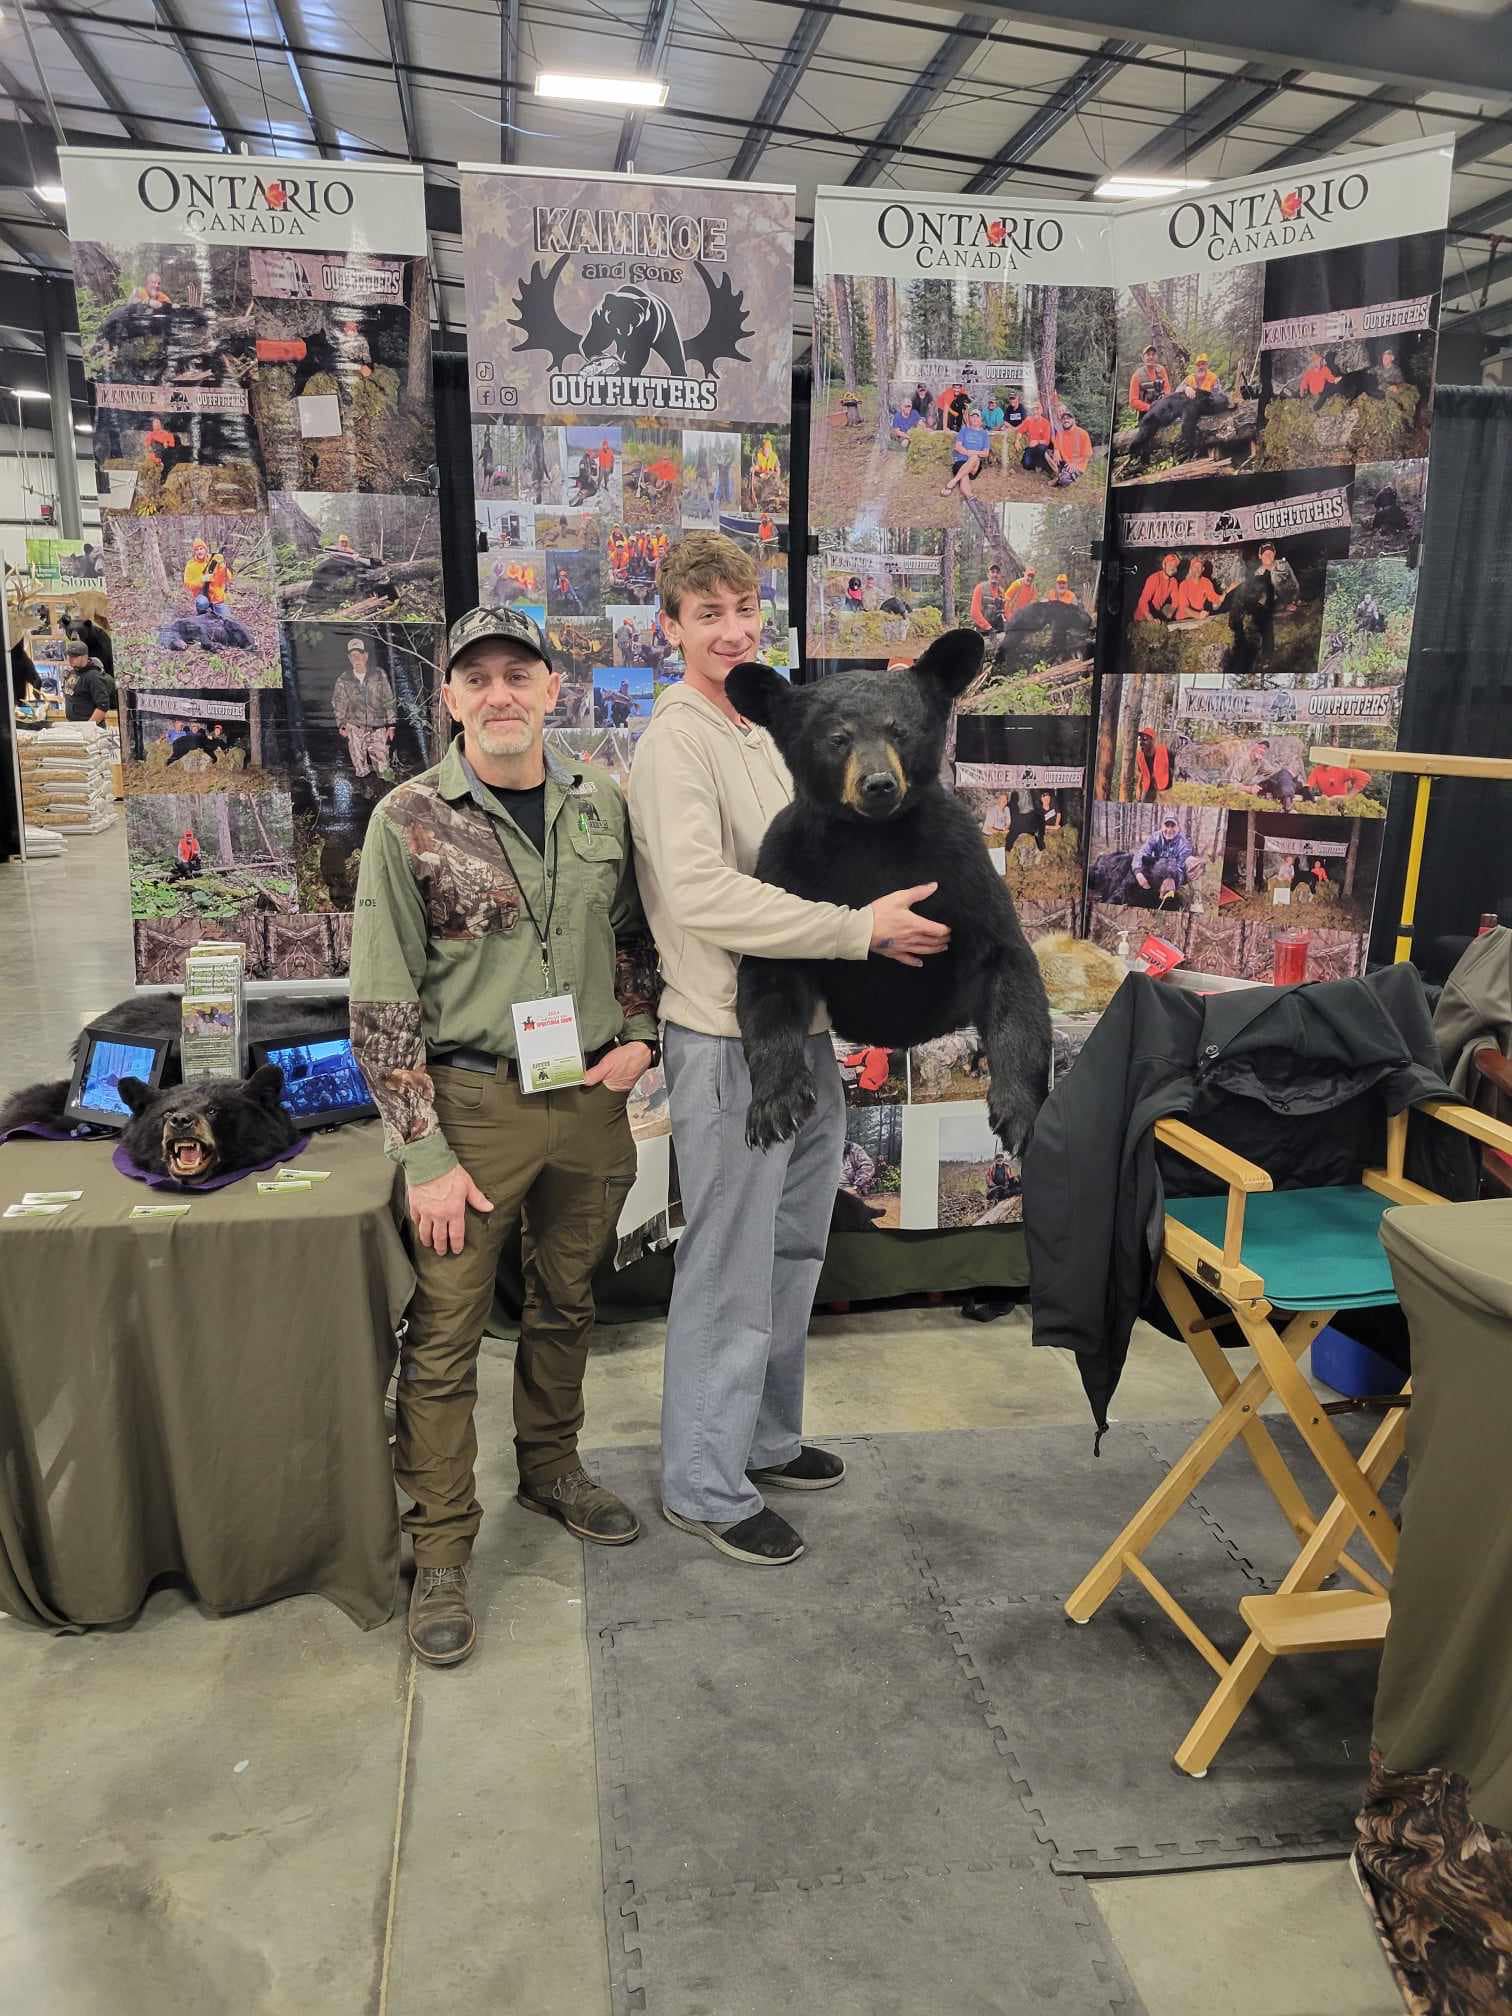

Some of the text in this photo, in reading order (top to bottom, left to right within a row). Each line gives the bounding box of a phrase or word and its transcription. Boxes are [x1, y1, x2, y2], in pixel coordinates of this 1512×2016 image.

[138, 166, 354, 222] ONTARIO
[1168, 174, 1369, 249] ONTARIO
[187, 210, 304, 235] CANADA
[534, 206, 728, 263] KAMMOE
[878, 204, 1063, 258] ONTARIO
[916, 246, 1018, 270] CANADA
[1207, 223, 1315, 261] CANADA
[582, 261, 626, 280] and
[1363, 302, 1427, 331] OUTFITTERS
[550, 374, 719, 411] OUTFITTERS
[1126, 519, 1197, 542] KAMMOE
[1253, 495, 1344, 532] OUTFITTERS
[1308, 694, 1391, 716] OUTFITTERS
